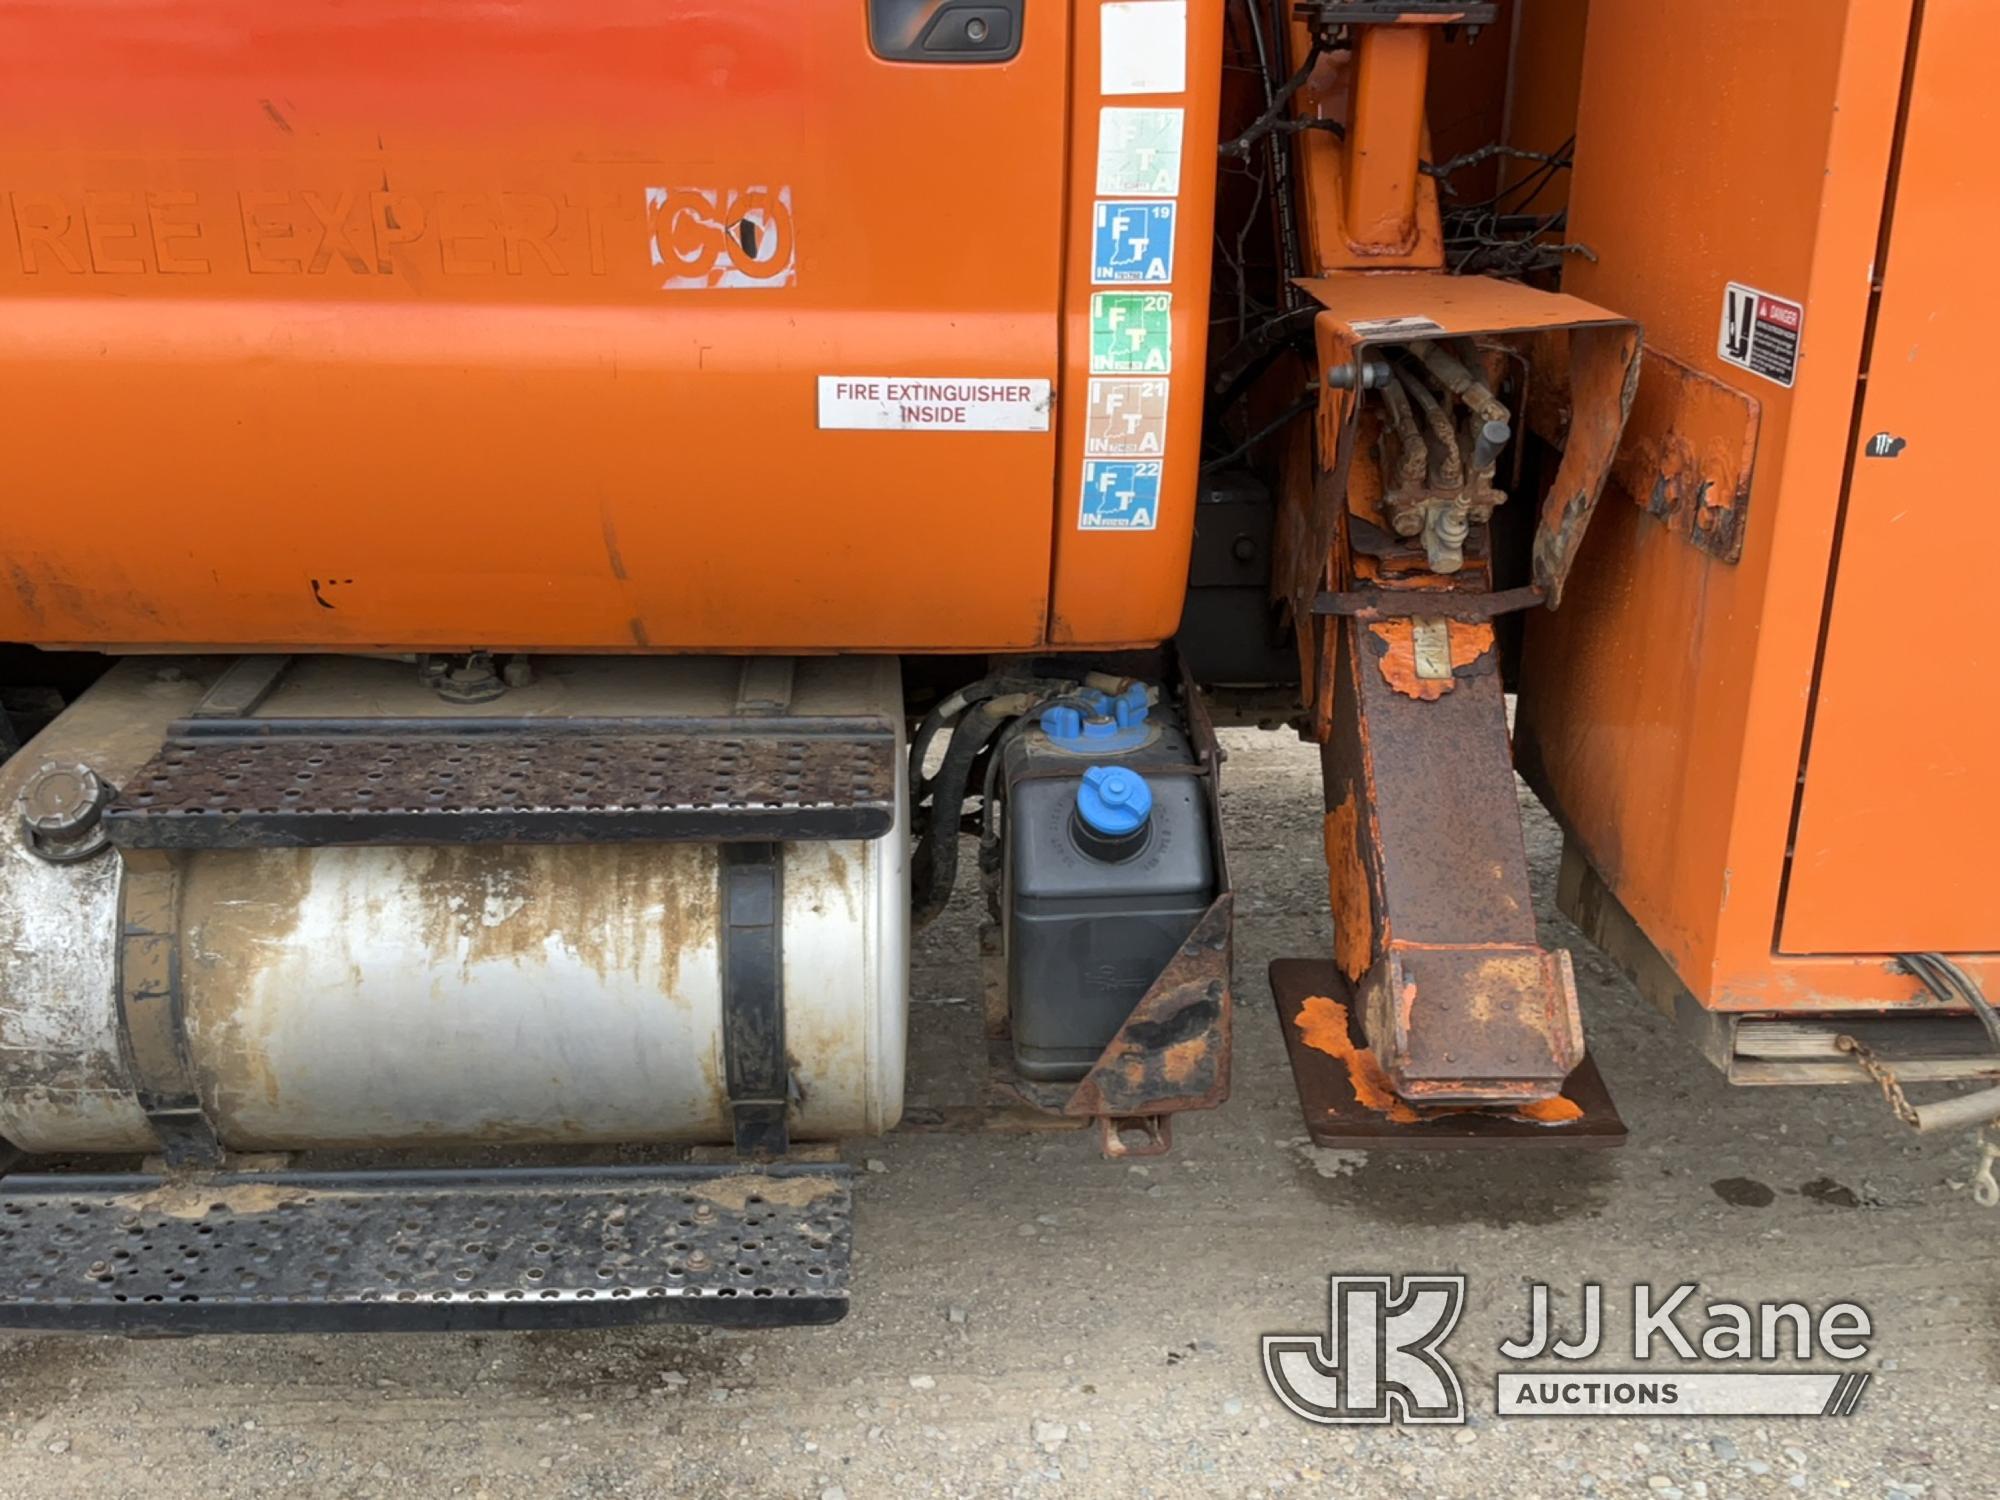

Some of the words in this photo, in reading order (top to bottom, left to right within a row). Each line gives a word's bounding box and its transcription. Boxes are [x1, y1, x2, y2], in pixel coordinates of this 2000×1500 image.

[1152, 206, 1171, 219] 19
[237, 191, 622, 276] EXPERT
[1096, 267, 1113, 278] IN
[1143, 296, 1167, 311] 20
[1094, 355, 1114, 369] IN
[836, 383, 879, 400] FIRE
[887, 384, 1031, 402] EXTINGUISHER
[1141, 382, 1163, 397] 21
[900, 405, 966, 423] INSIDE
[1090, 438, 1109, 452] IN
[1135, 463, 1158, 476] 22
[1083, 513, 1102, 526] IN
